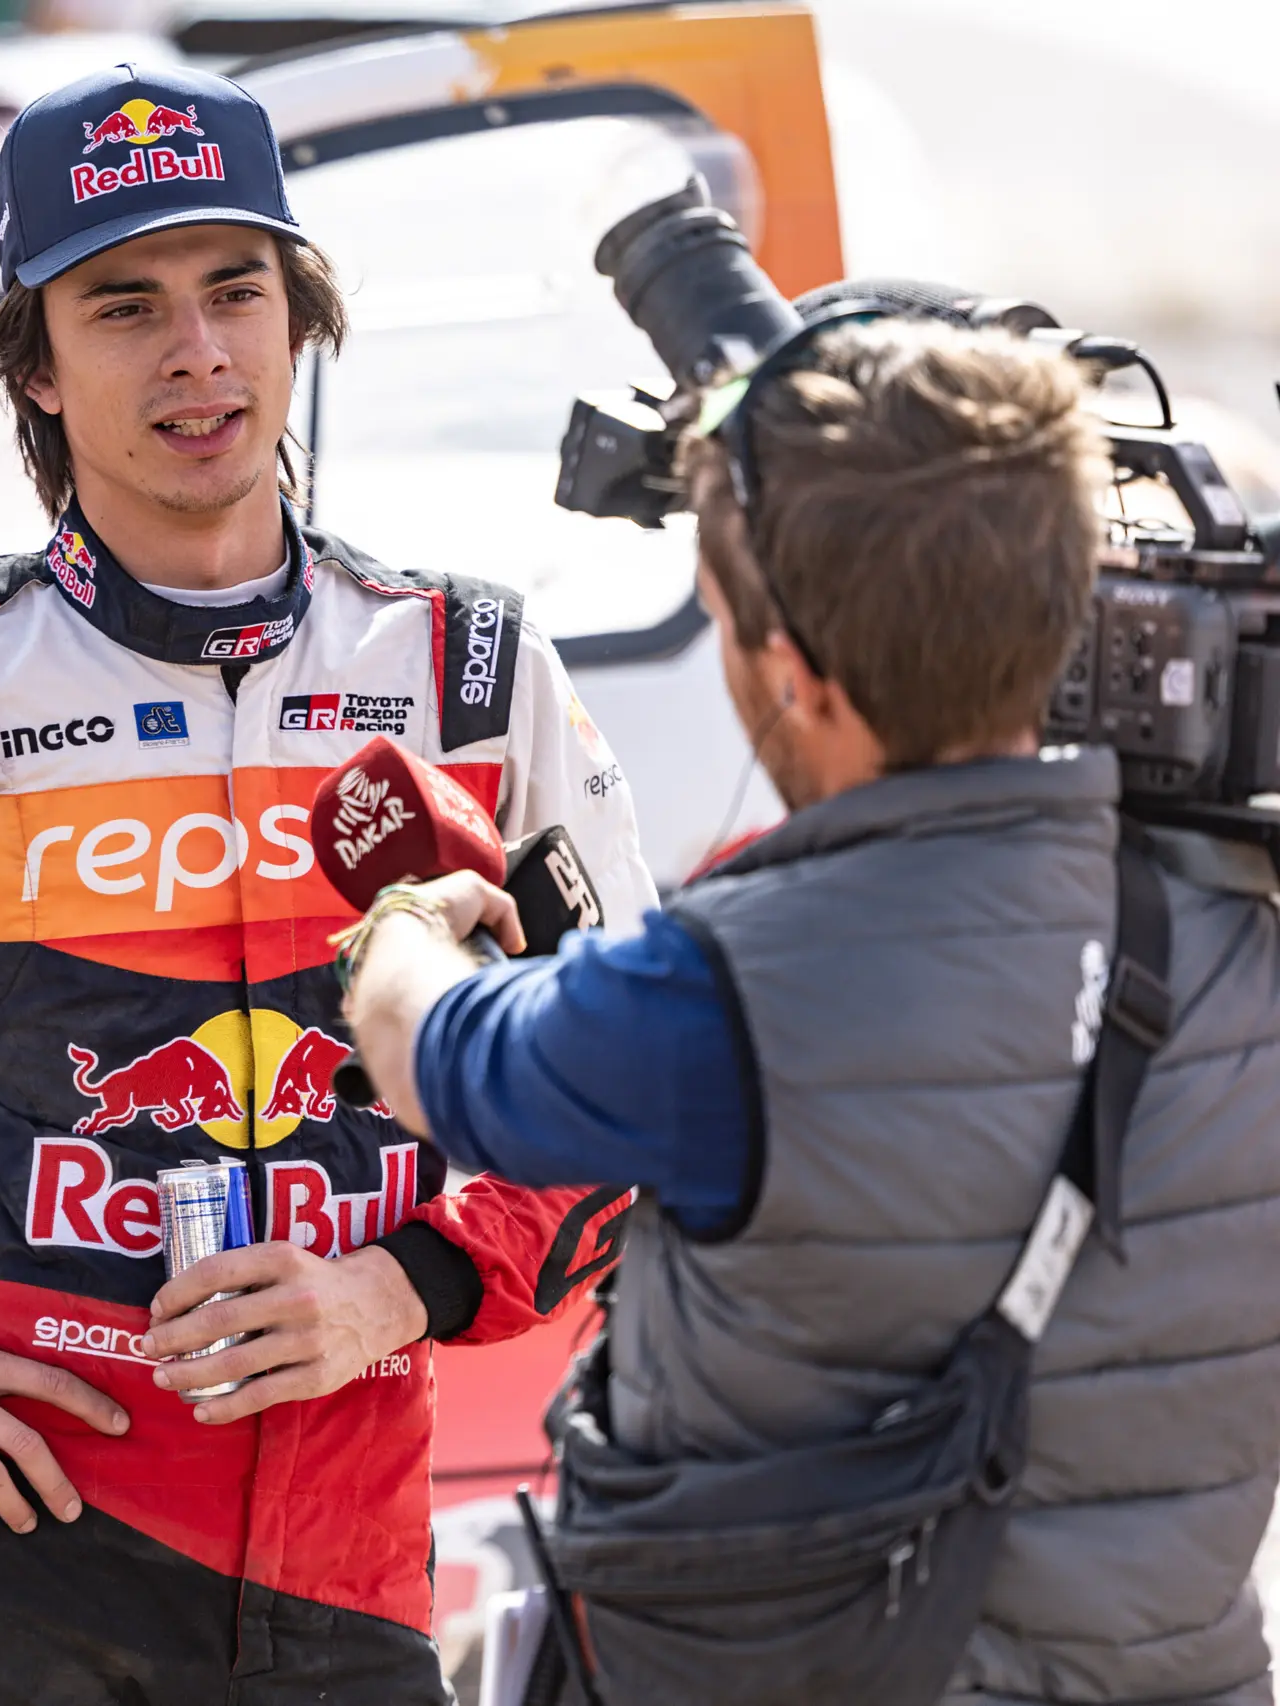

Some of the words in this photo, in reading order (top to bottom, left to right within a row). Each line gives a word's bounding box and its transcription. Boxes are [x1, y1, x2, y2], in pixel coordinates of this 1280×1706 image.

[71, 149, 147, 202] Red
[149, 144, 224, 182] Bull
[64, 567, 95, 608] Bull
[207, 637, 260, 656] GR
[461, 599, 498, 706] sparco
[282, 707, 335, 729] GR
[342, 707, 407, 719] GAZOO
[345, 693, 415, 708] TOYOTA
[339, 719, 405, 735] Racing
[334, 797, 416, 869] DAKAR
[21, 804, 316, 912] reps
[28, 1139, 162, 1256] Re
[267, 1143, 418, 1258] Bull
[34, 1316, 160, 1359] sparc
